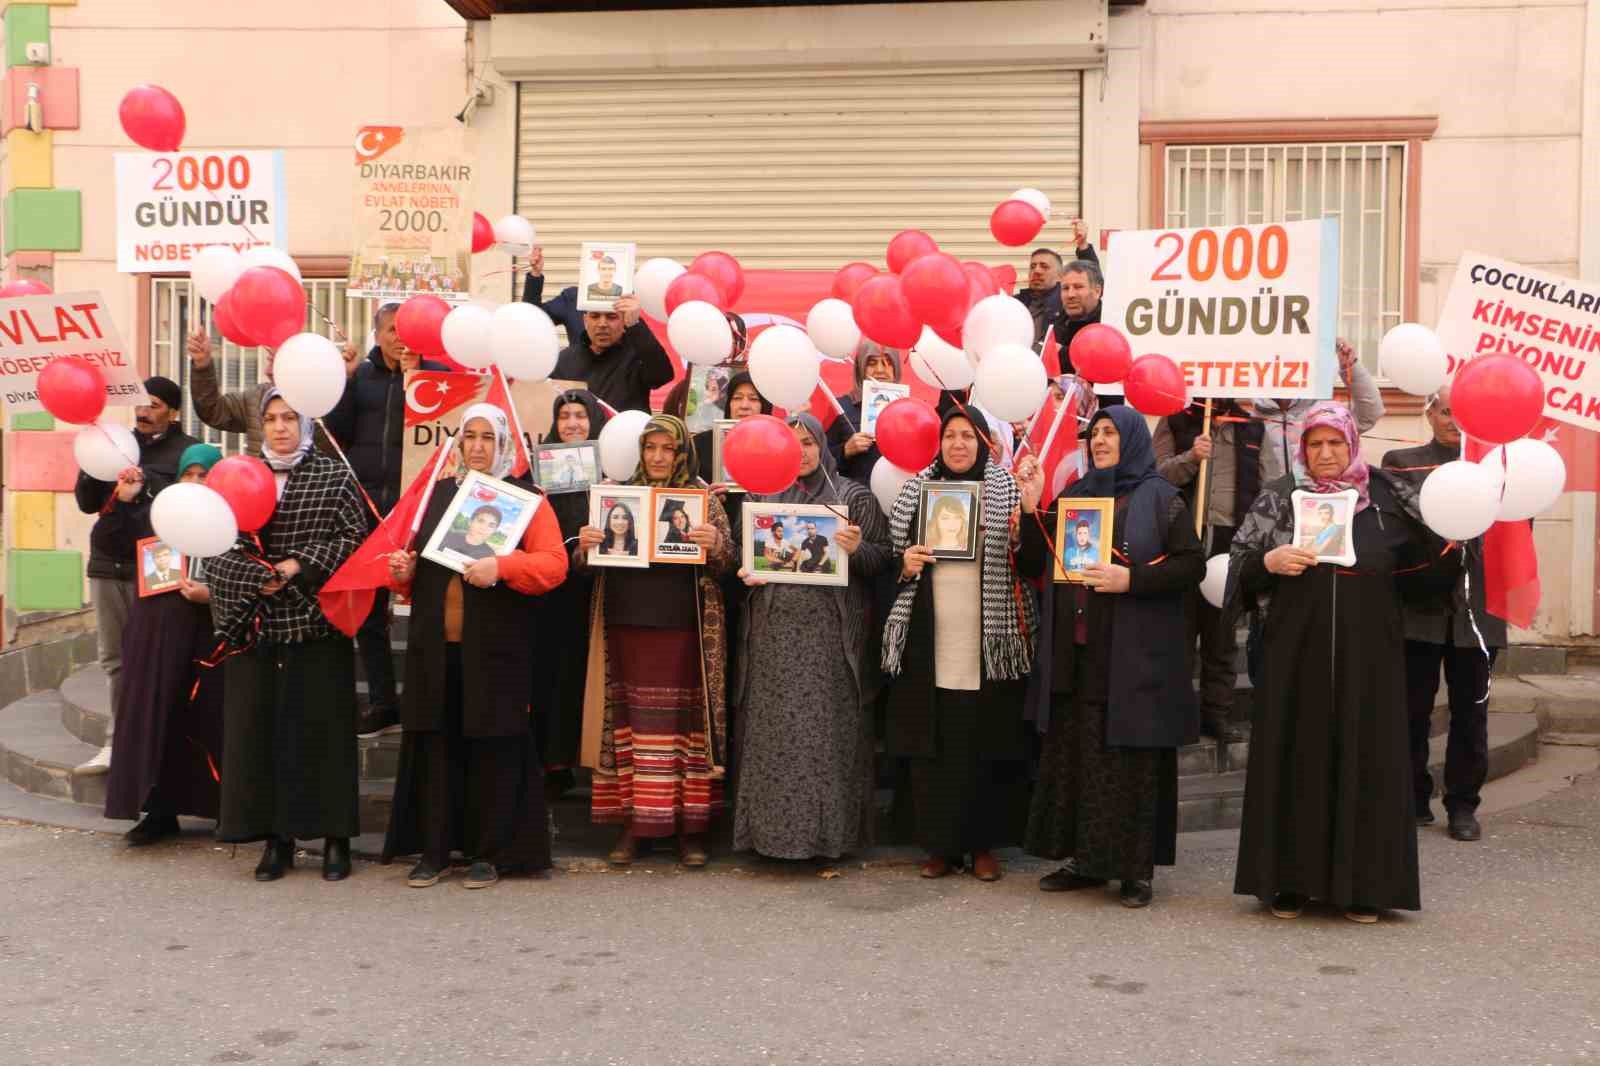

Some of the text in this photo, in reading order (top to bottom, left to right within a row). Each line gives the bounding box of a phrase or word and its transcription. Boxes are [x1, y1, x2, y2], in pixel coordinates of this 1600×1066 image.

[152, 155, 250, 191] 2000
[135, 195, 269, 227] GÜNDÜR
[365, 195, 406, 207] EVLAT
[379, 209, 448, 232] 2000.
[1150, 225, 1288, 282] 2000
[1470, 264, 1600, 315] ÇOCUKLARI
[0, 303, 103, 346] VLAT
[1125, 287, 1310, 335] GÜNDÜR
[1181, 355, 1309, 388] ETTEYİZ!
[1475, 332, 1586, 380] PİYONU
